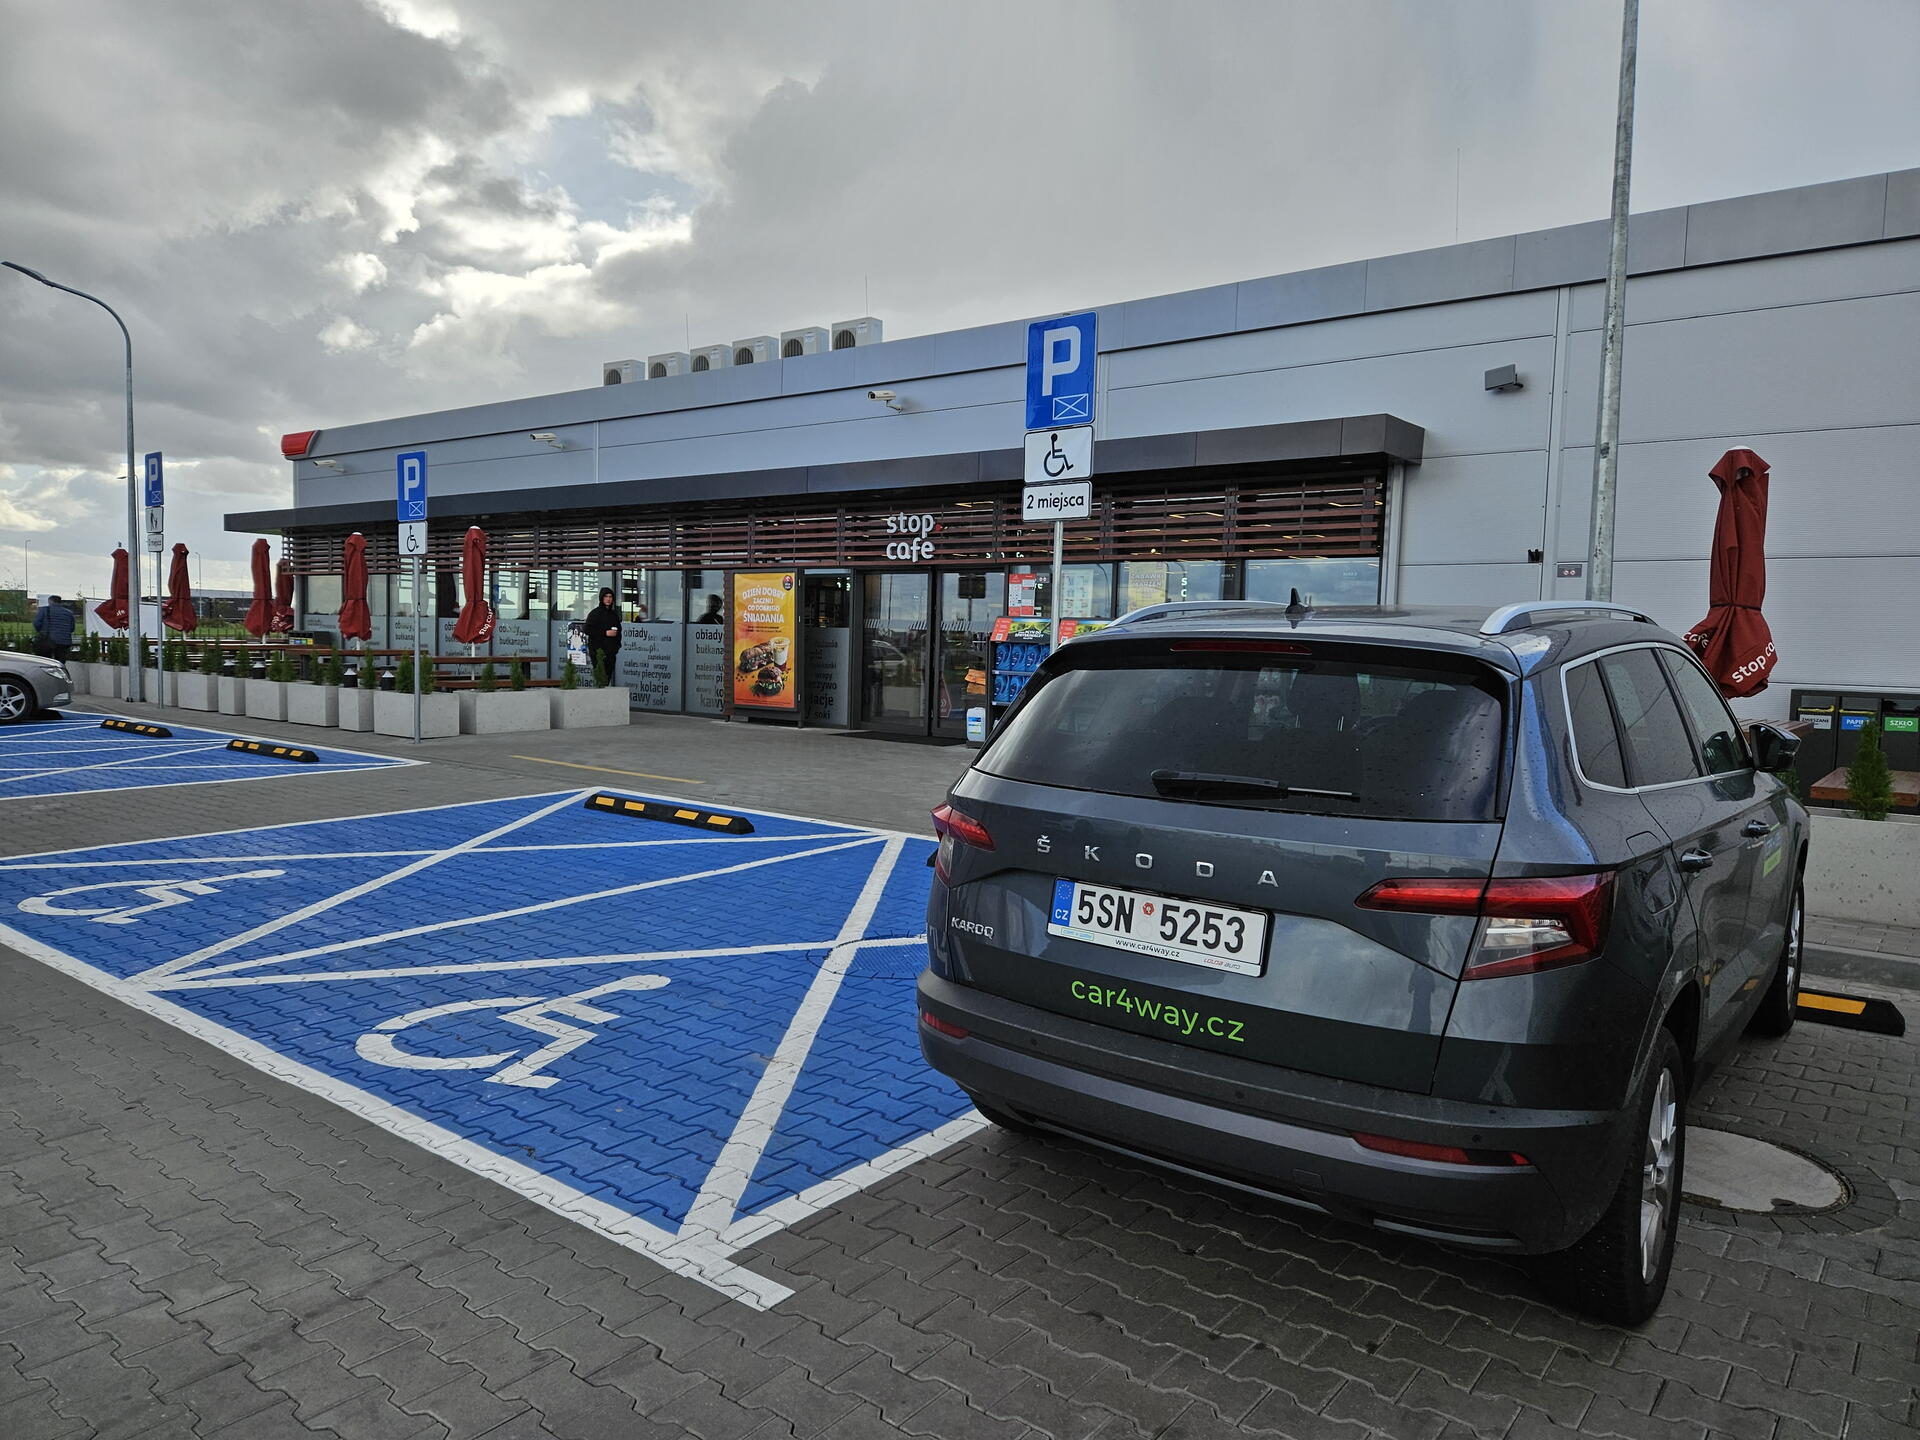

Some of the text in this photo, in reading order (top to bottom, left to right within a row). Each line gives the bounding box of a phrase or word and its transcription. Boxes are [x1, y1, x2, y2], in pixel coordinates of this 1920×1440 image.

[1041, 325, 1082, 397] P
[148, 457, 158, 492] P
[403, 458, 420, 501] P
[1026, 492, 1084, 512] 2 miejsca
[886, 511, 935, 539] stop
[886, 536, 936, 563] cafe
[743, 609, 785, 623] ŚNIADANIA
[695, 628, 723, 644] obiady
[641, 669, 672, 682] pieczywo
[1731, 655, 1767, 684] stop
[640, 681, 669, 695] kolacje
[1036, 834, 1279, 888] ŠKODA
[951, 916, 994, 940] KAROQ
[1054, 908, 1069, 921] CZ
[1077, 889, 1246, 954] 5SN 5253
[1115, 939, 1181, 958] www.car4way.cz
[1071, 980, 1245, 1043] car4way.cz
